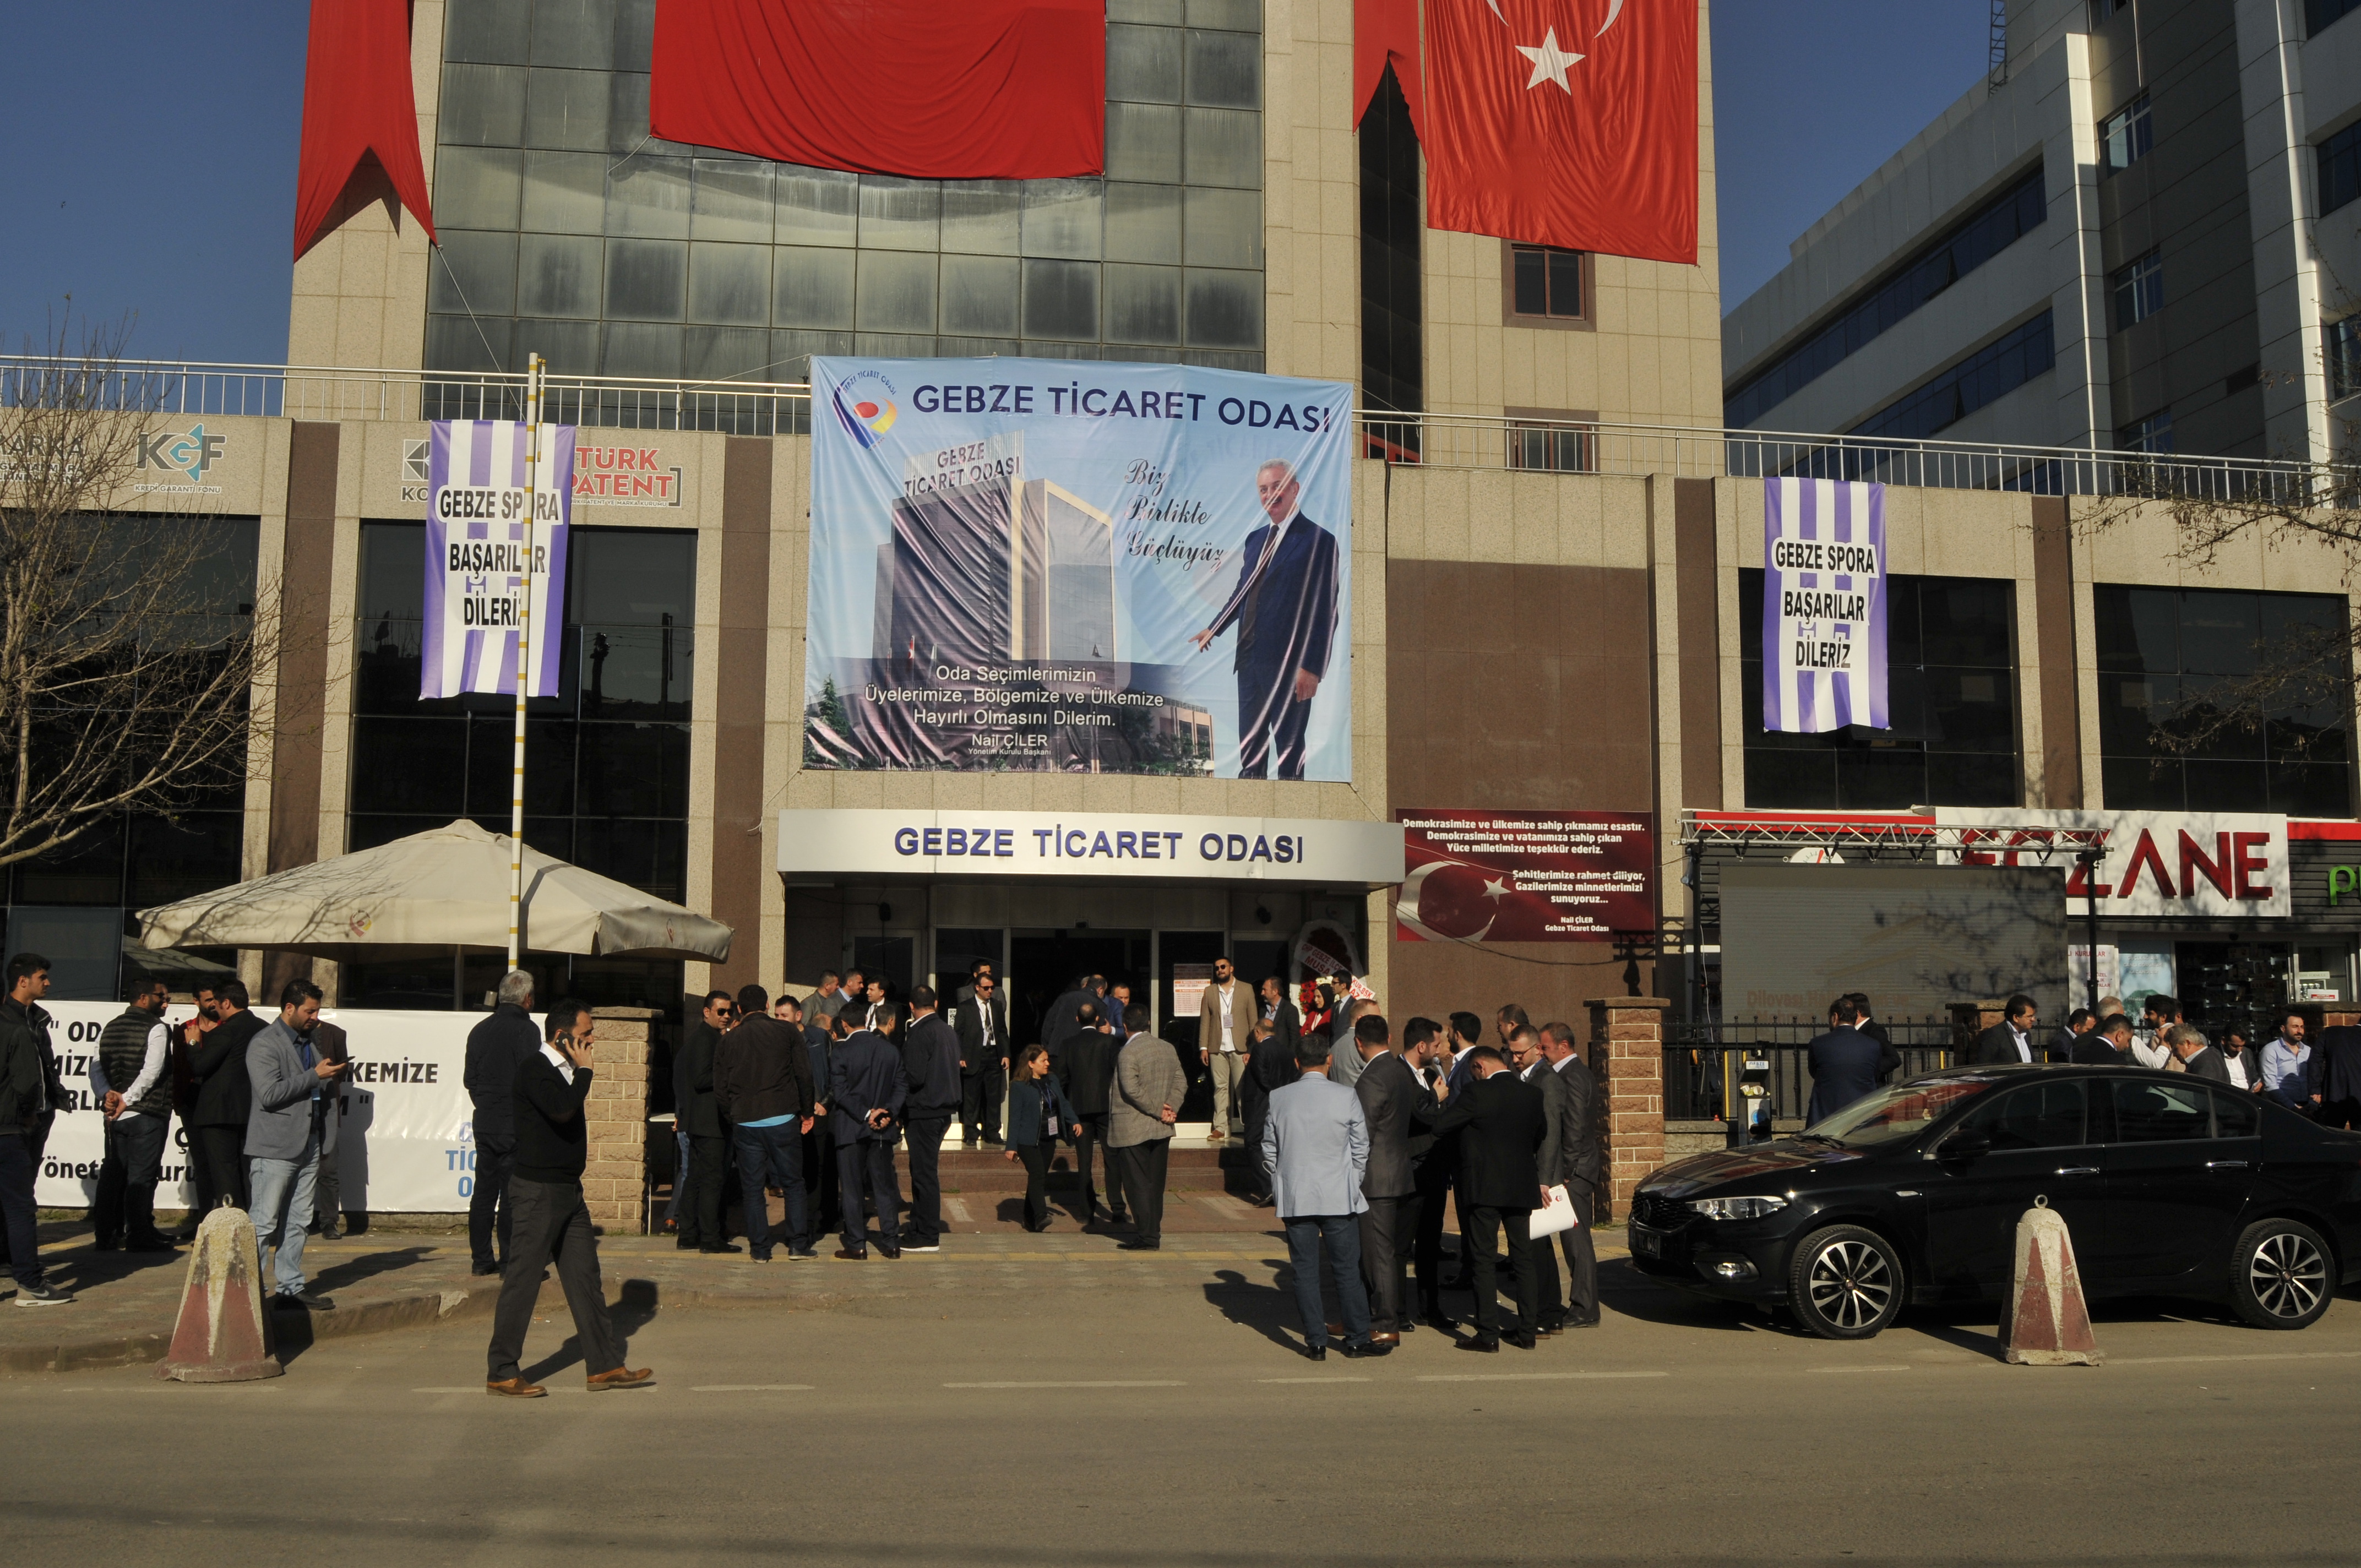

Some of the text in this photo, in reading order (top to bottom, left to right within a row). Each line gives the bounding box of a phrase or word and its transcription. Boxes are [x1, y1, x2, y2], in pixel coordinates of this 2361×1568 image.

[881, 375, 896, 395] ODASI
[913, 381, 1330, 433] GEBZE TİCARET ODASI
[137, 423, 227, 482] KGF
[575, 447, 660, 471] TÜRK
[938, 442, 984, 468] GEBZE
[135, 483, 158, 492] KREDİ
[160, 484, 195, 493] GARANTİ
[905, 456, 1019, 497] TİCARET ODASI
[1124, 459, 1171, 496] Biz
[440, 489, 558, 520] GEBZE SPRA
[1124, 495, 1212, 525] Birlikte
[450, 543, 546, 579] BAŞARILR
[1127, 531, 1224, 573] Güçlüyüz
[1775, 541, 1875, 574] GEBZE SPORA
[464, 590, 521, 626] DİLERİ
[1784, 590, 1864, 624] BAŞARILAR
[1796, 634, 1851, 669] DİLERİZ
[936, 666, 1096, 684] Oda Seçimlerimizin
[865, 684, 1163, 707] Üyelerimize, Bölgemize ve Ülkemize
[914, 709, 1116, 727] Hayırlı Olmasını Dilerim.
[972, 732, 1048, 749] Nail ÇİLER
[1403, 819, 1476, 829] Demokrasimize
[1492, 820, 1535, 829] ülkemize
[1537, 820, 1563, 831] sahip
[1565, 821, 1608, 831] çıkmamız
[1611, 823, 1645, 831] esastır.
[895, 824, 1303, 864] GEBZE TİCARET ODASI
[1427, 831, 1500, 841] Demokrasimize
[1516, 833, 1568, 841] vatanımıza
[1570, 833, 1595, 843] sahip
[1597, 834, 1622, 843] çıkan
[1446, 843, 1603, 854] Yüce milletimize teşekkür ederiz.
[1513, 870, 1645, 881] Şehitlerimize rahmet diliyor,
[1515, 882, 1643, 892] Gazilerimize minnetlerimizi
[1551, 895, 1608, 905] sunuyoruz...
[1575, 916, 1593, 924] ÇİLER
[1304, 956, 1331, 976] MUSA
[1312, 949, 1331, 964] GEBZE
